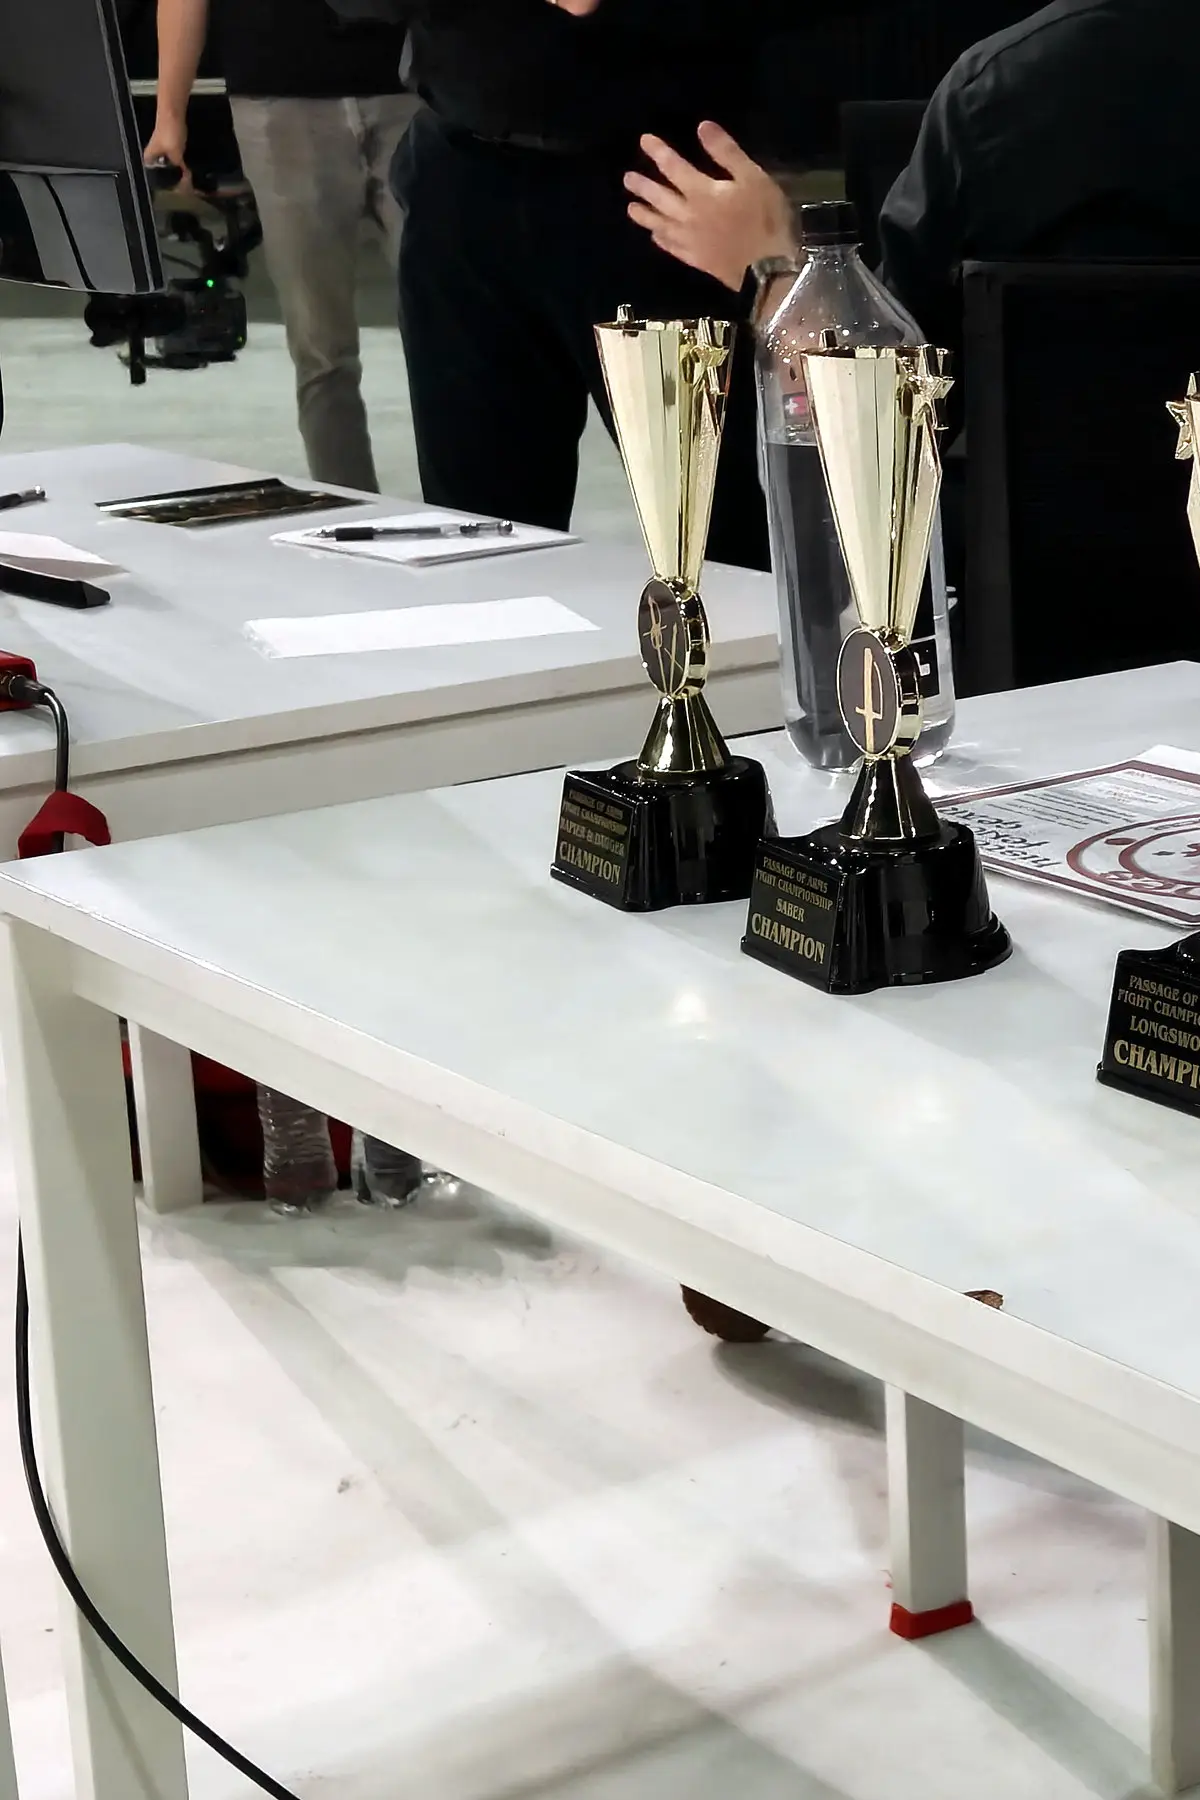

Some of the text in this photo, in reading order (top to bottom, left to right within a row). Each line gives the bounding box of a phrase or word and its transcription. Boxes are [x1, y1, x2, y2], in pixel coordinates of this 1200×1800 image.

[559, 840, 621, 885] CHAMPION
[763, 856, 829, 894] PASSAGE OF ARMS
[755, 868, 833, 911] FIGHT CHAMPIONSHIP
[775, 898, 805, 922] SABER
[751, 912, 826, 964] CHAMPION
[1117, 988, 1152, 1010] FIGHT
[1129, 975, 1180, 1002] PASSAGE
[1182, 991, 1199, 1007] OF
